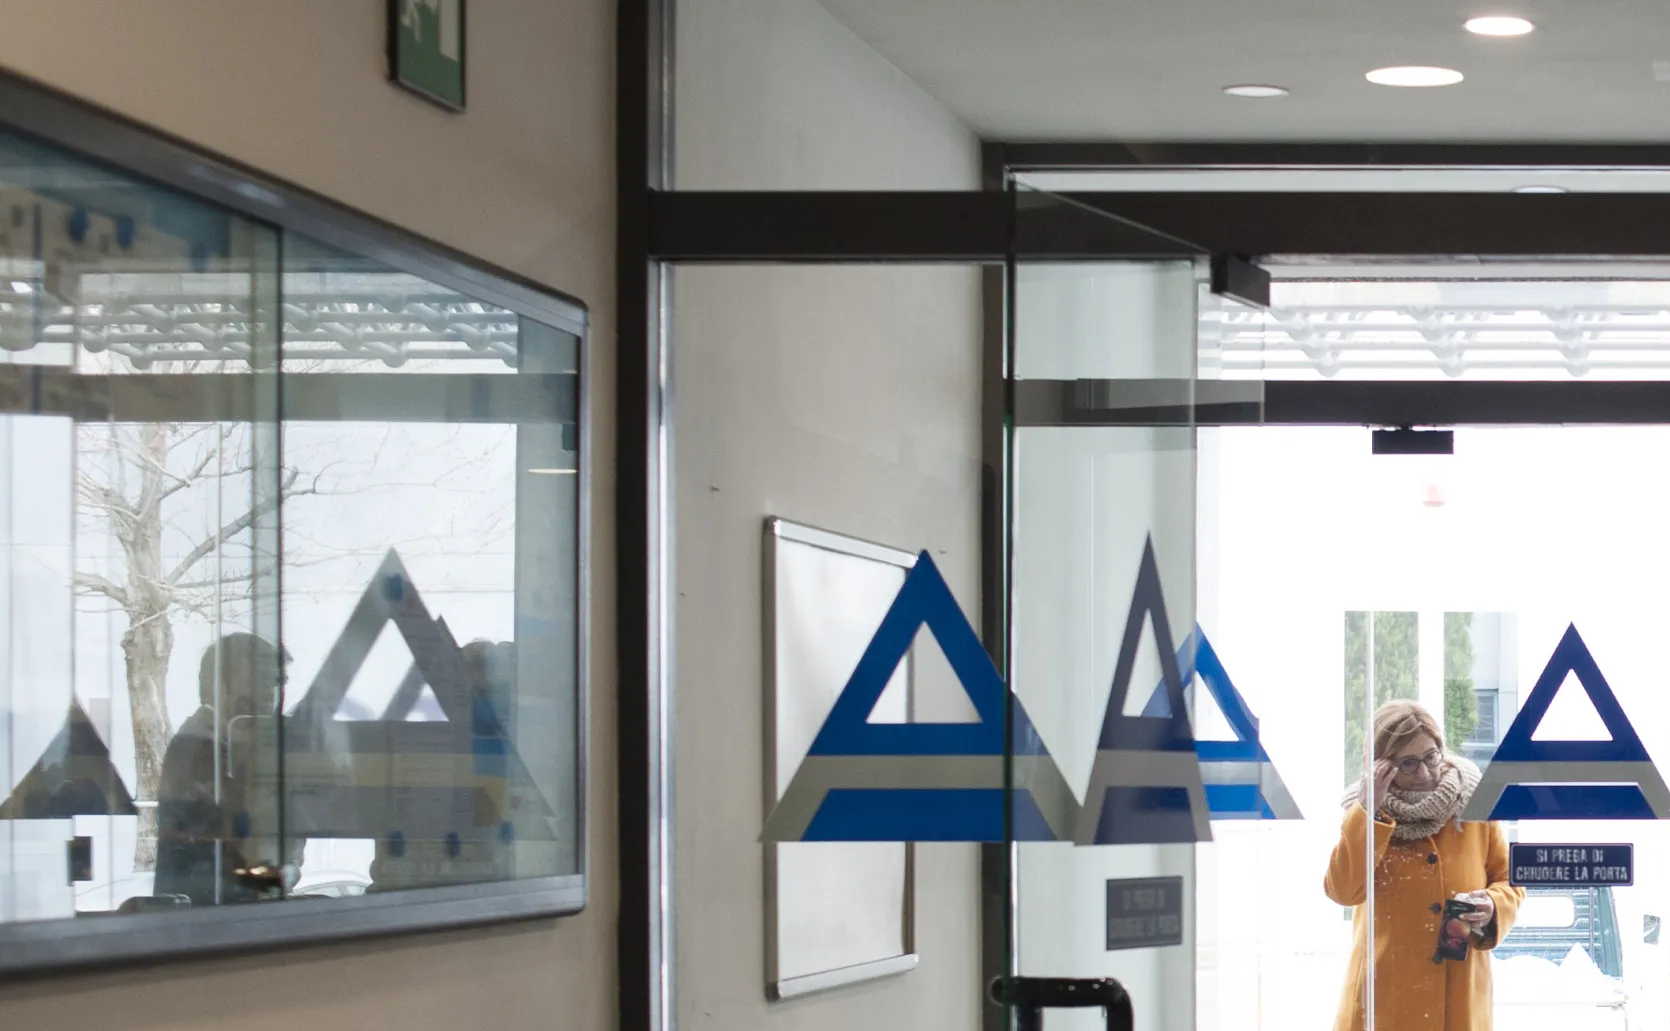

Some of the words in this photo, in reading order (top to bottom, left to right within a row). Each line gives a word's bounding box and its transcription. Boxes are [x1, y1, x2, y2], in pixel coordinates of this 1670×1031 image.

[1536, 849, 1548, 863] SI
[1552, 849, 1588, 863] PREGA
[1592, 849, 1604, 863] DI
[1516, 867, 1570, 881] CHIUDERE
[1574, 867, 1589, 881] LA
[1593, 867, 1628, 881] PORTA
